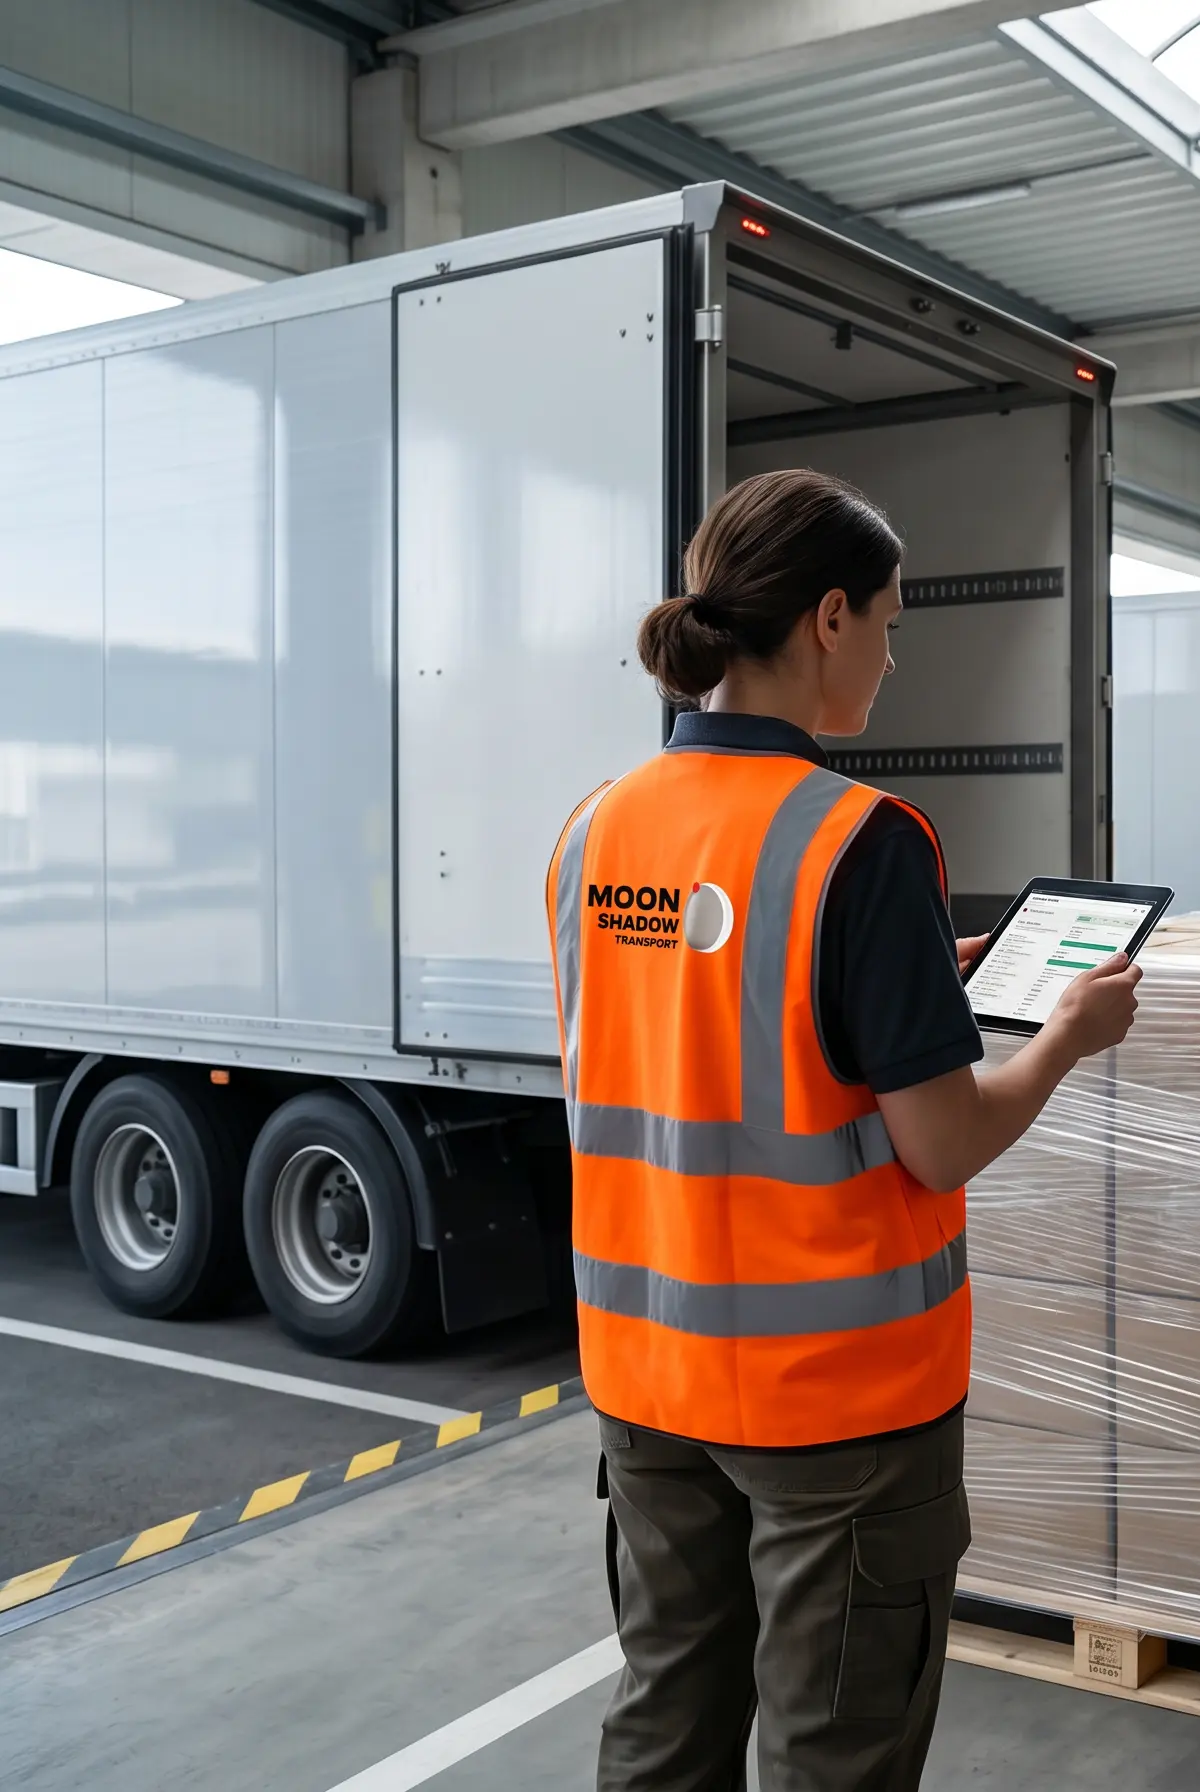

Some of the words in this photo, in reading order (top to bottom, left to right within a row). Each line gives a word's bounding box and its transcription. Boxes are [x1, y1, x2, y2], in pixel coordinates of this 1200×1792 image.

[587, 884, 681, 913] MOON
[597, 912, 680, 934] SHADOW
[615, 934, 678, 949] TRANSPORT
